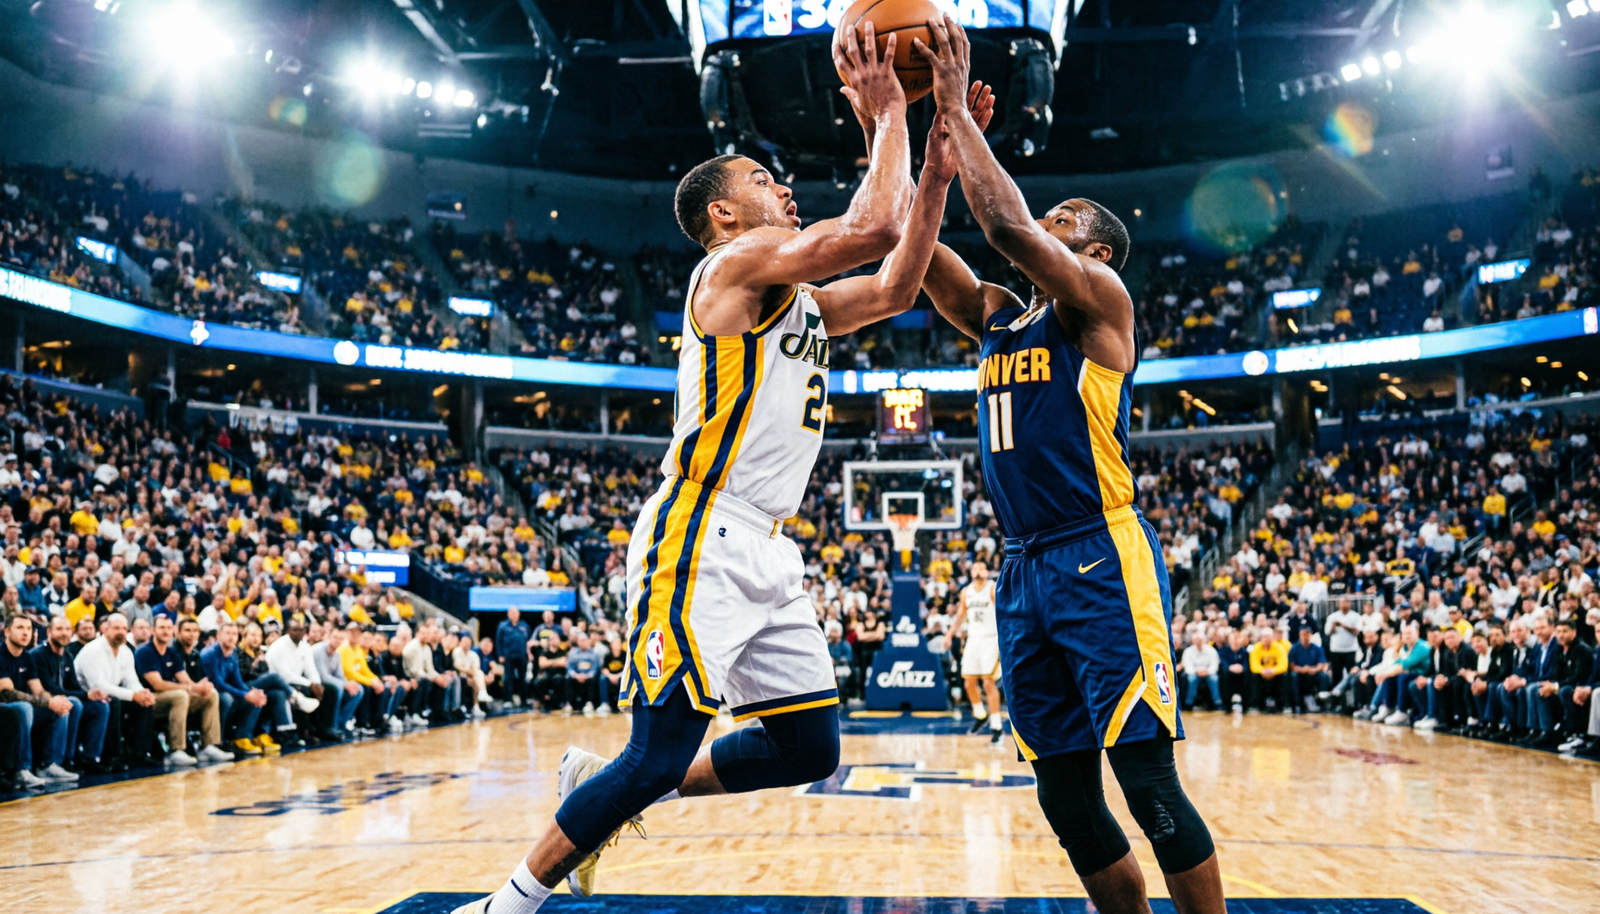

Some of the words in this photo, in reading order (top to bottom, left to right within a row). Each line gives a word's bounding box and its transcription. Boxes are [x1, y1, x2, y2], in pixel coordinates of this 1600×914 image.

[977, 347, 1052, 395] NVER
[801, 371, 826, 435] 2
[988, 391, 1015, 453] 11
